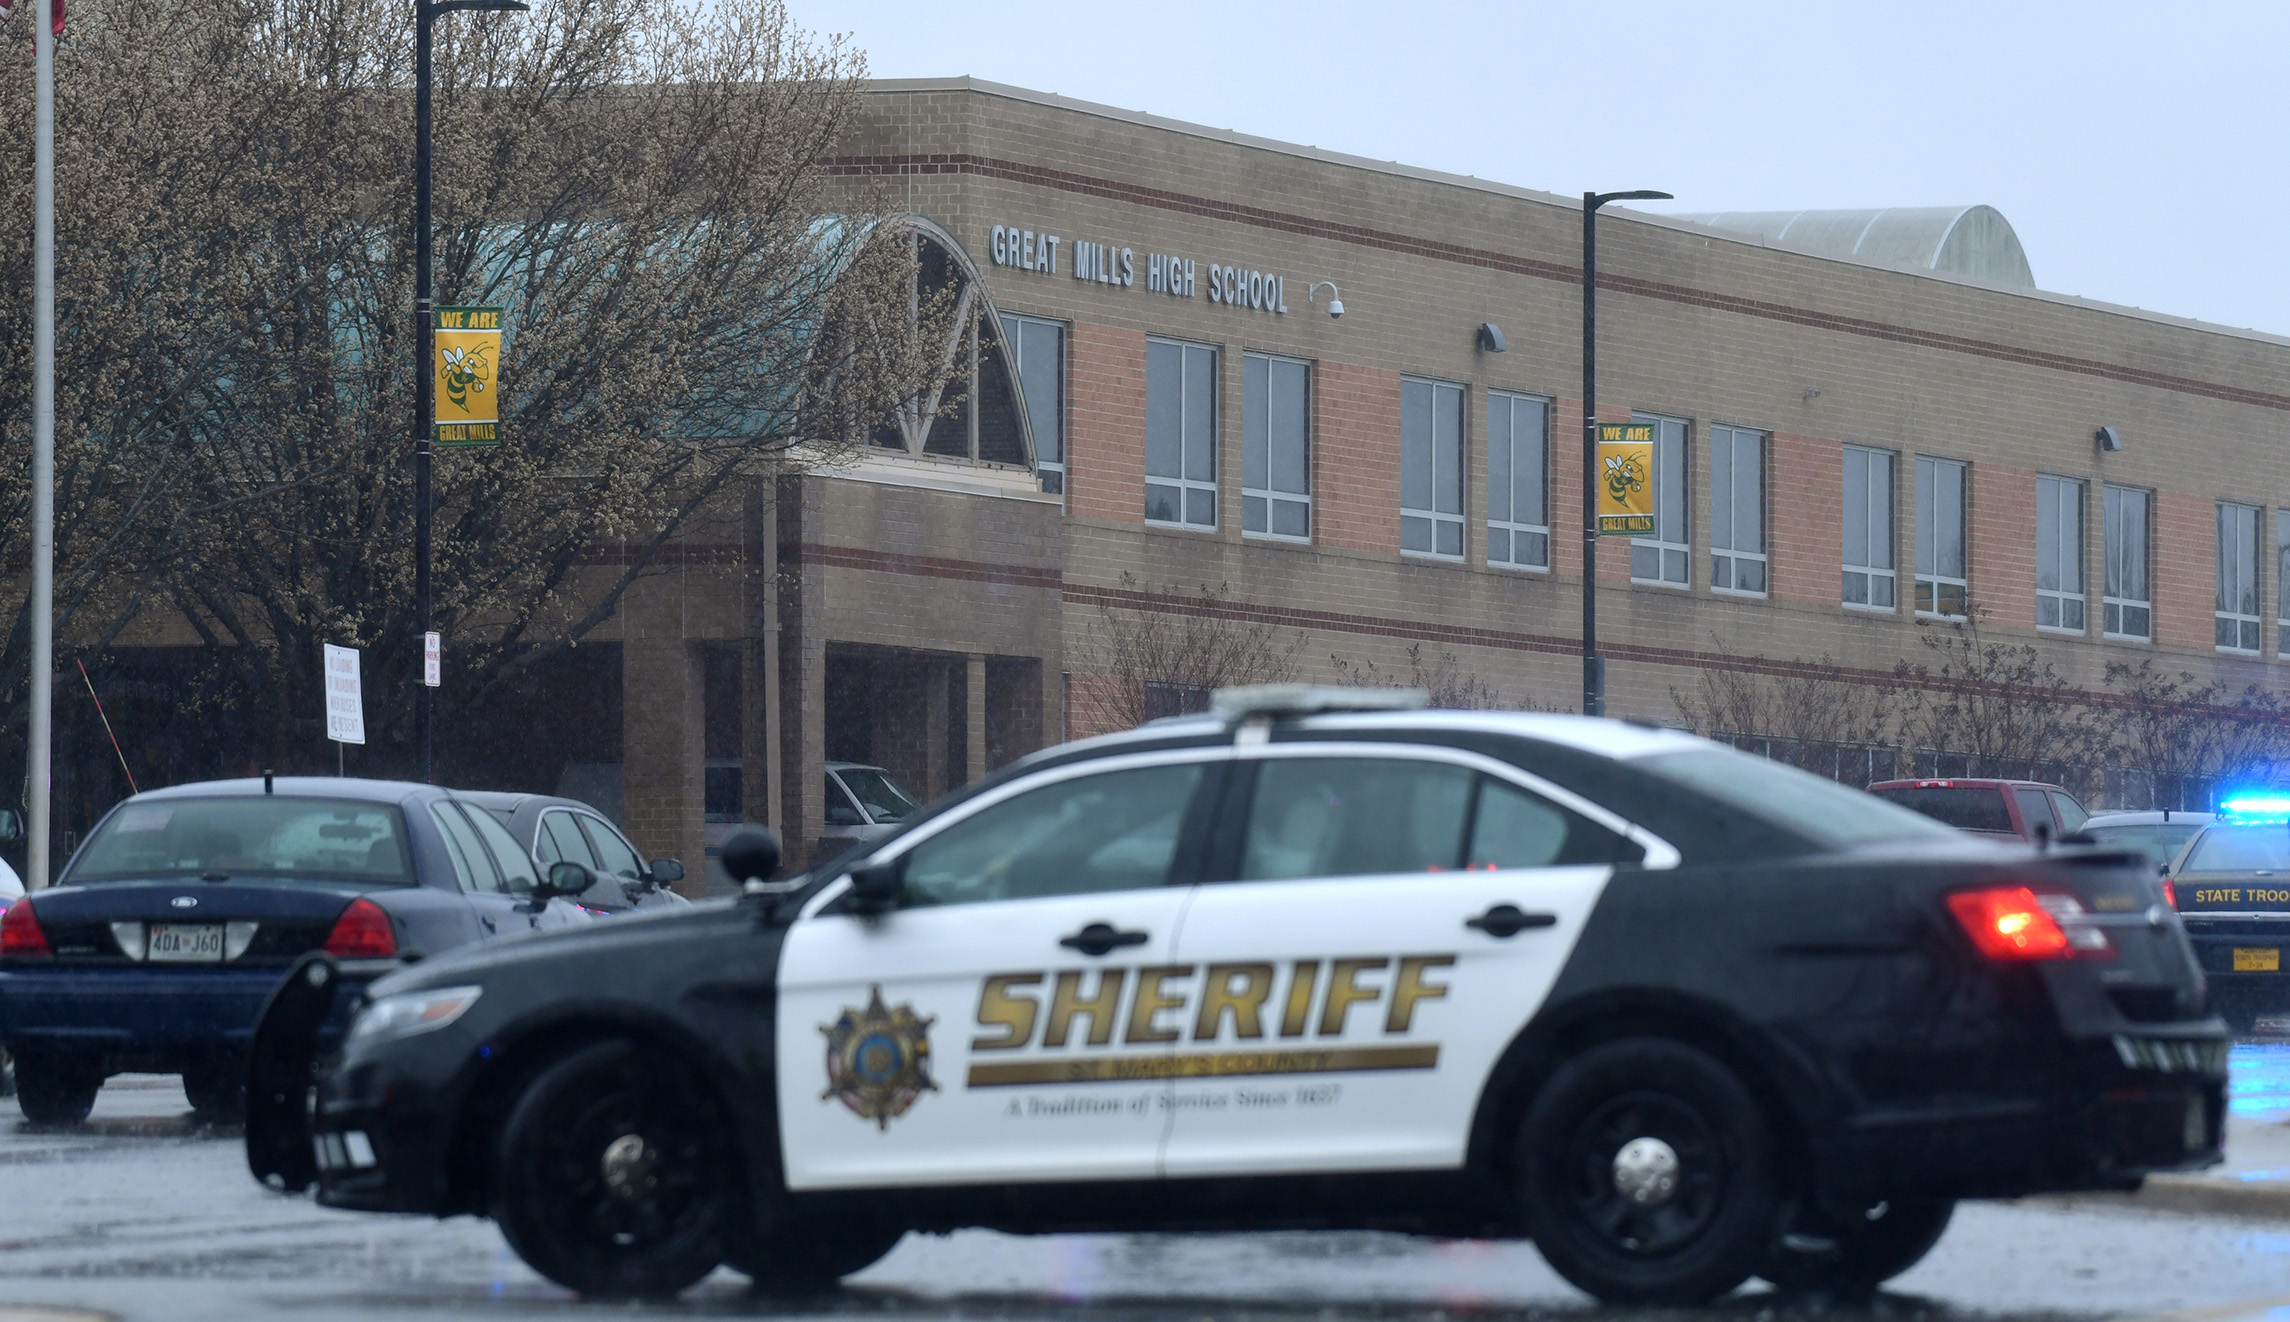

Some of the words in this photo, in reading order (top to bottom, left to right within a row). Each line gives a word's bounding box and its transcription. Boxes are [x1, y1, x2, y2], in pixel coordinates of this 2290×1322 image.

[990, 224, 1060, 274] GREAT
[1073, 240, 1134, 287] MILLS
[1146, 253, 1195, 297] HIGH
[1207, 263, 1288, 313] SCHOOL
[441, 311, 464, 328] WE
[468, 312, 499, 329] ARE
[440, 424, 467, 441] GREAT
[469, 424, 496, 440] MILLS
[1603, 427, 1622, 440] WE
[1625, 427, 1651, 441] ARE
[1602, 517, 1626, 531] GREAT
[1628, 517, 1651, 530] MILLS
[2196, 889, 2241, 902] STATE
[2247, 889, 2290, 902] TROO
[971, 954, 1456, 1051] SHERIFF
